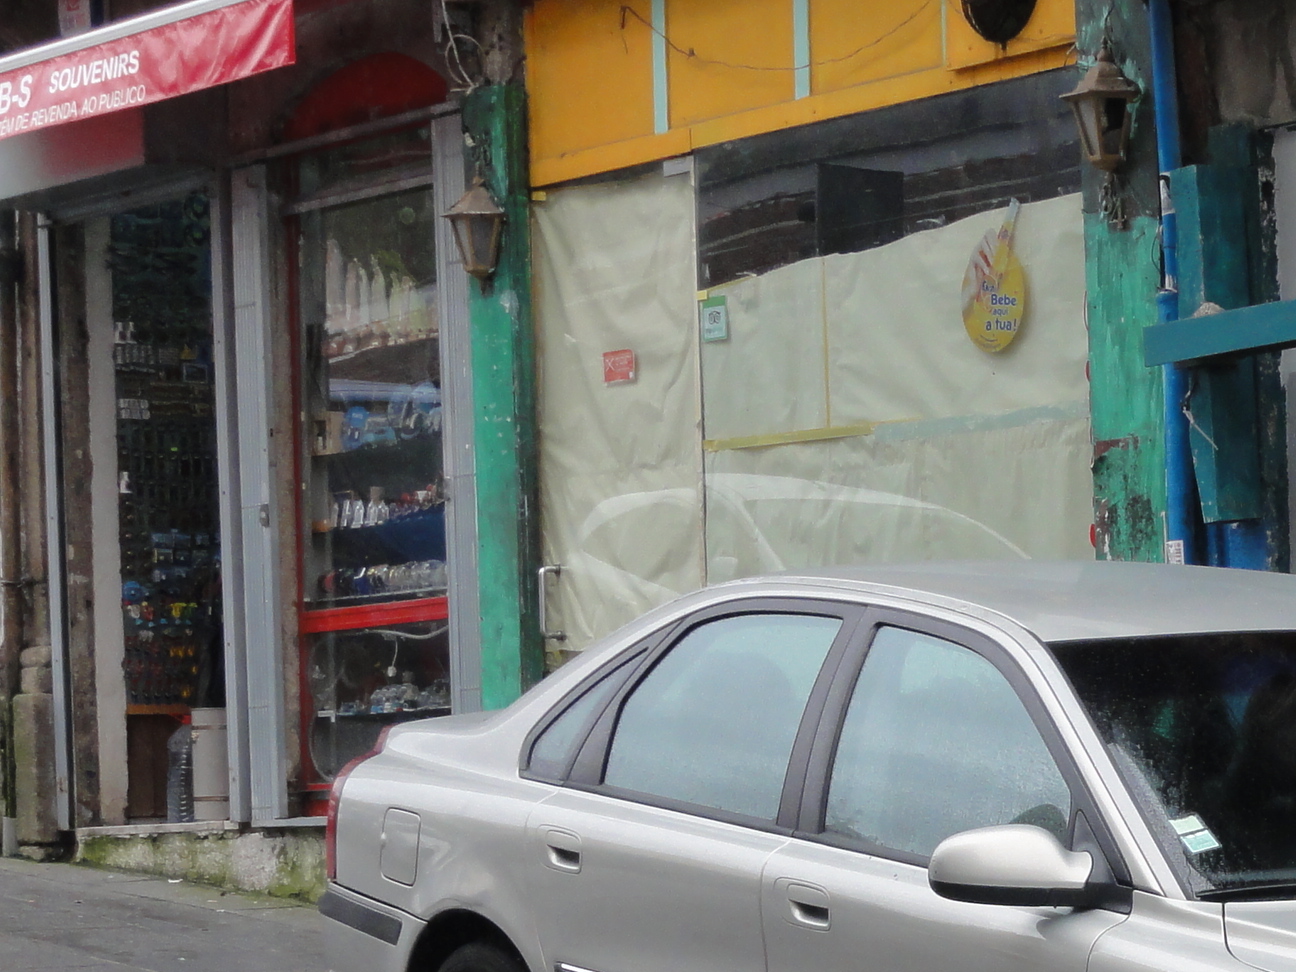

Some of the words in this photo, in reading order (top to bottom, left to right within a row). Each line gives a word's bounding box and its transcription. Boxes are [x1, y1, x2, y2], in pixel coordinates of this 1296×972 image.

[49, 50, 140, 94] SOUVENIRS
[15, 113, 30, 131] DE
[30, 100, 78, 127] REVENDA
[81, 96, 98, 116] AO
[991, 293, 1017, 306] Bebe
[985, 320, 992, 331] a
